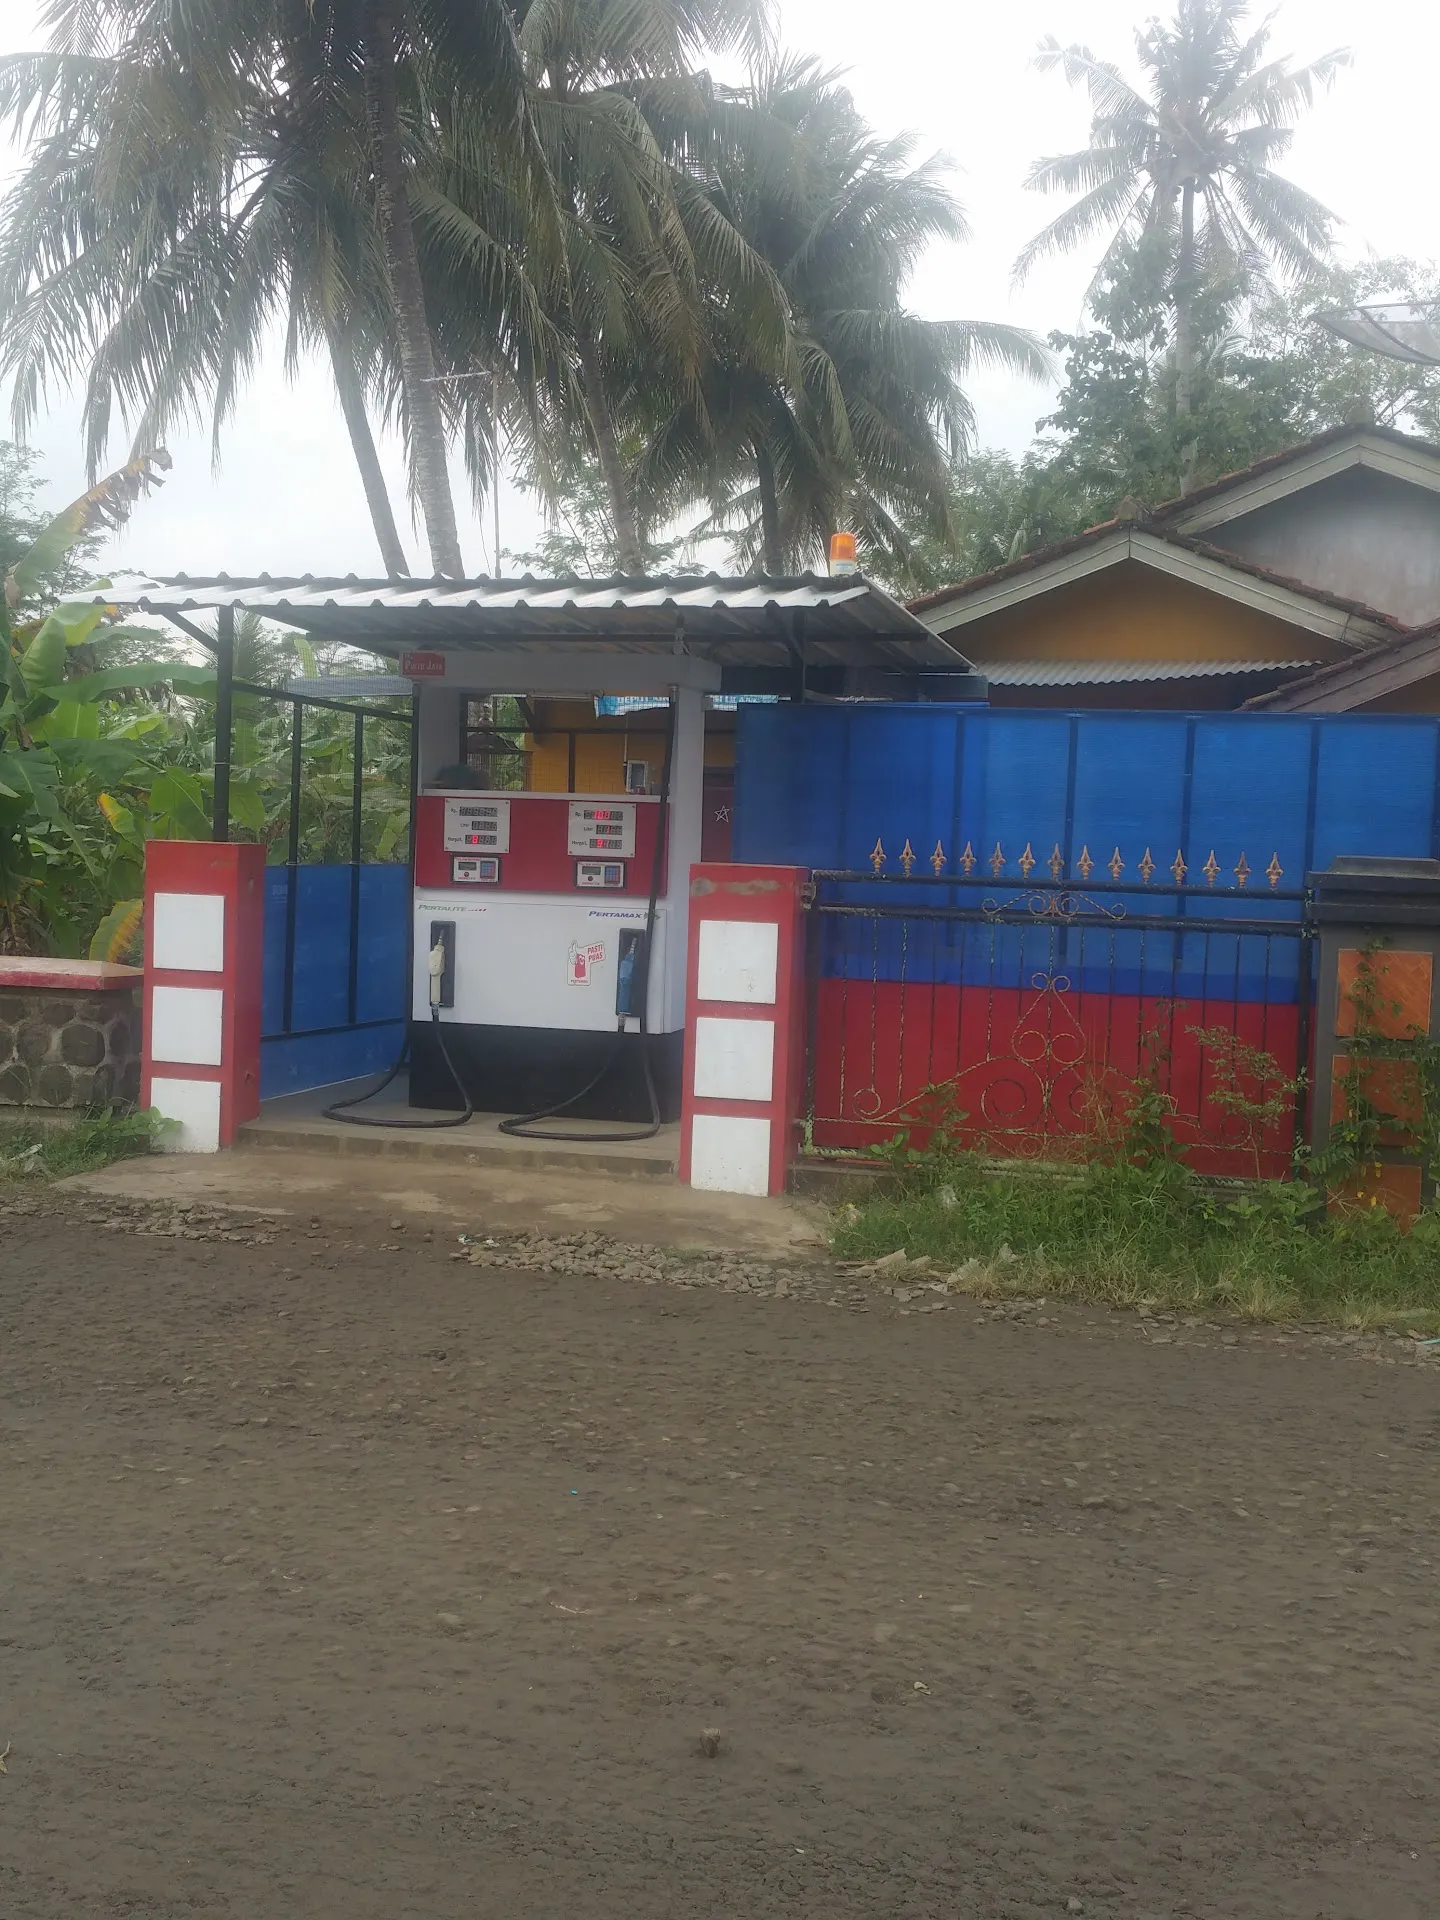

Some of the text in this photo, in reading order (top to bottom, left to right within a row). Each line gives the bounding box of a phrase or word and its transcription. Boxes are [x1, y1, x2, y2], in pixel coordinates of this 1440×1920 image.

[418, 904, 467, 912] PERTALITE
[588, 910, 642, 919] PERTAMAX
[587, 944, 603, 955] PASTI
[588, 952, 603, 962] PUAS
